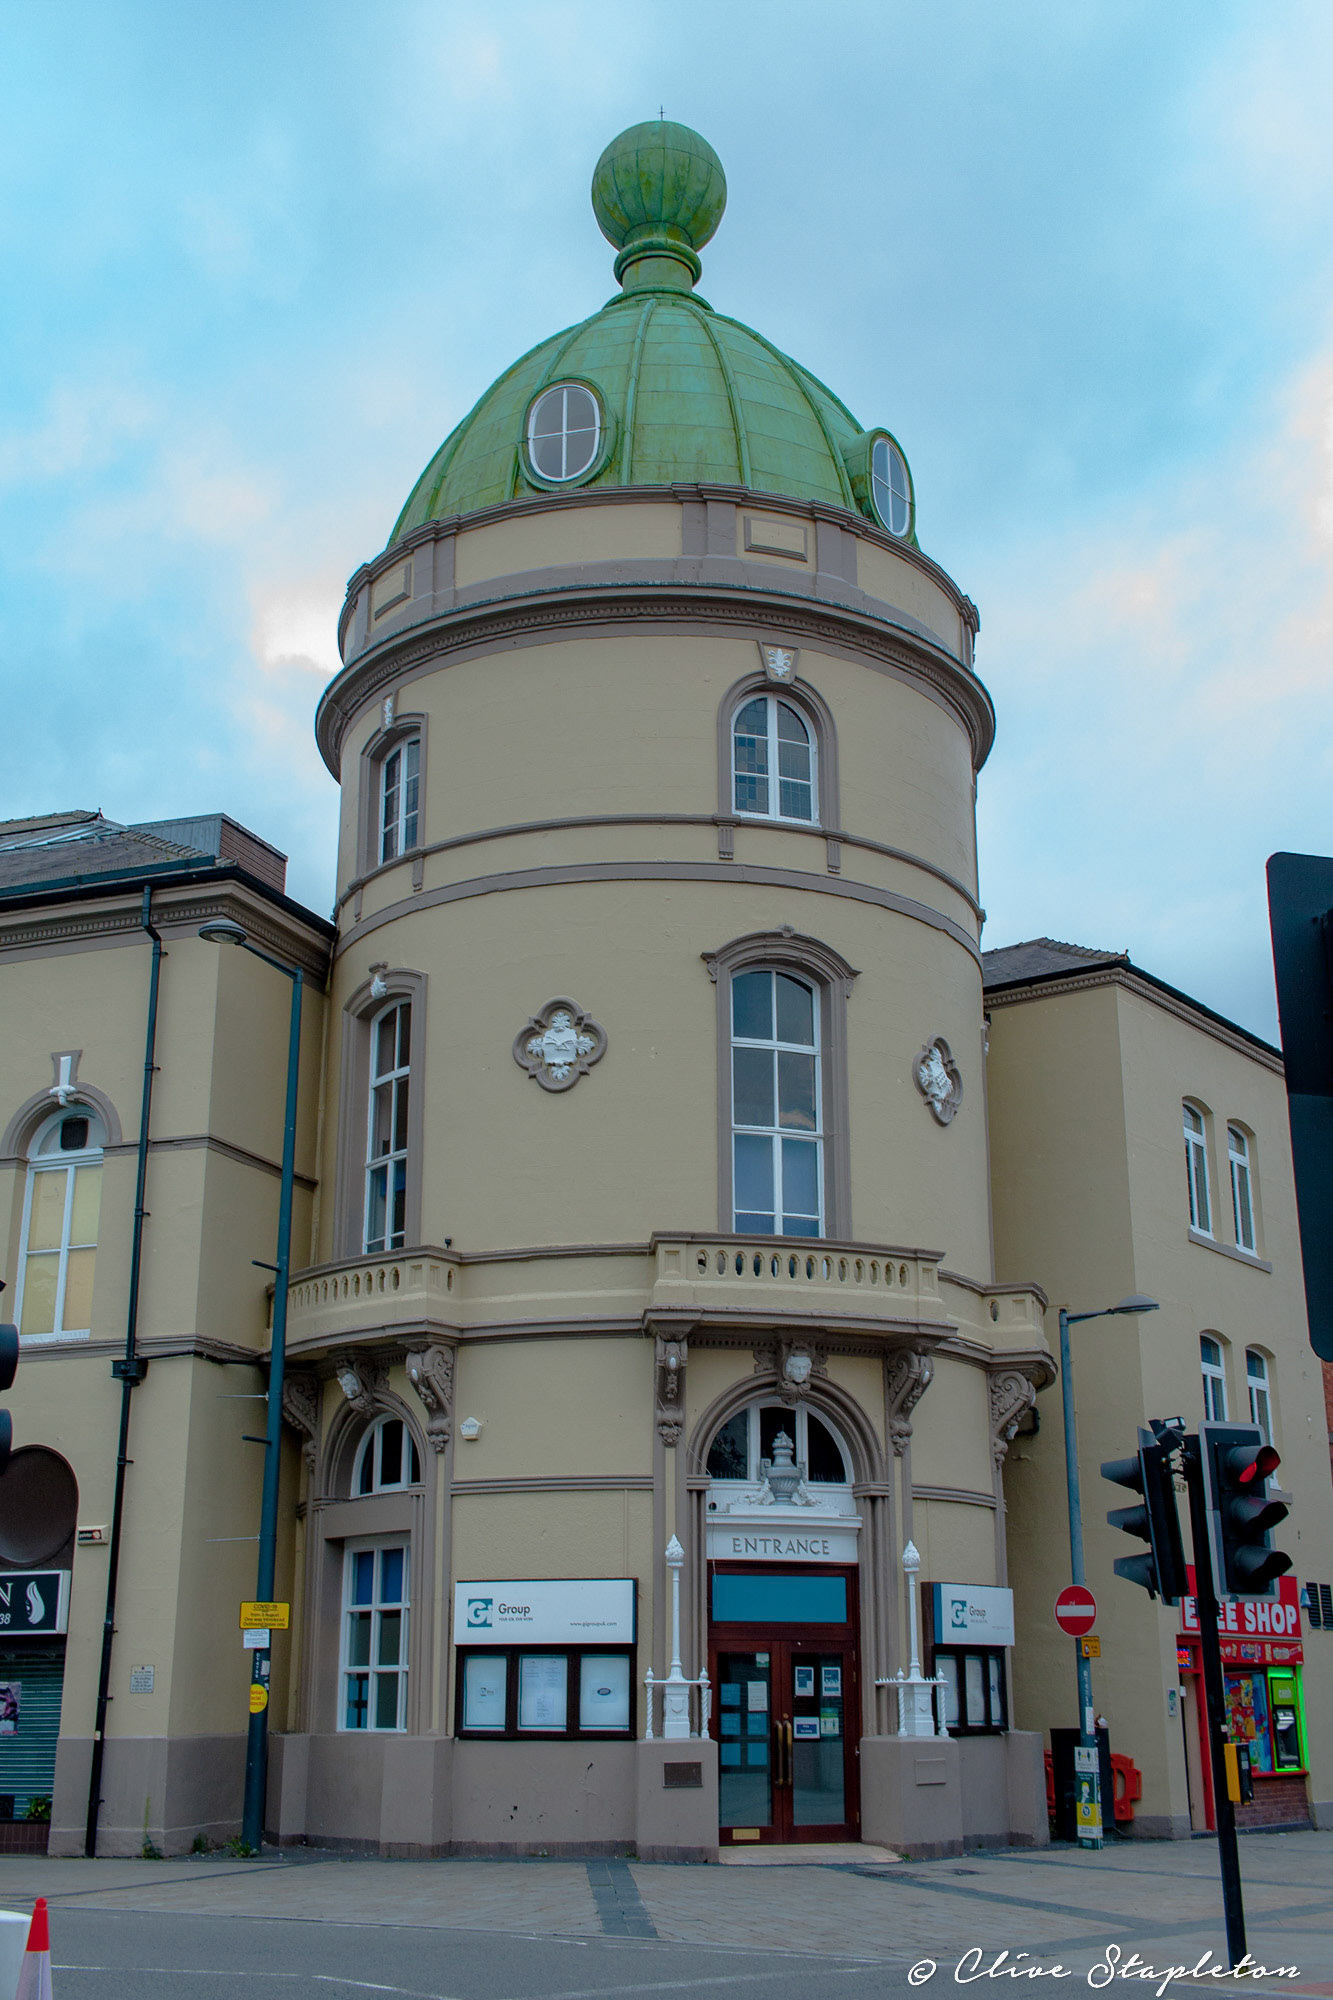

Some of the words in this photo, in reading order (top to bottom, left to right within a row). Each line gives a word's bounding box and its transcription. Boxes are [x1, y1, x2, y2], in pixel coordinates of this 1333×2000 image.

[732, 1537, 830, 1555] ENTRANCE
[498, 1603, 531, 1616] Group
[969, 1606, 987, 1619] Group
[1244, 1601, 1297, 1634] SHOP
